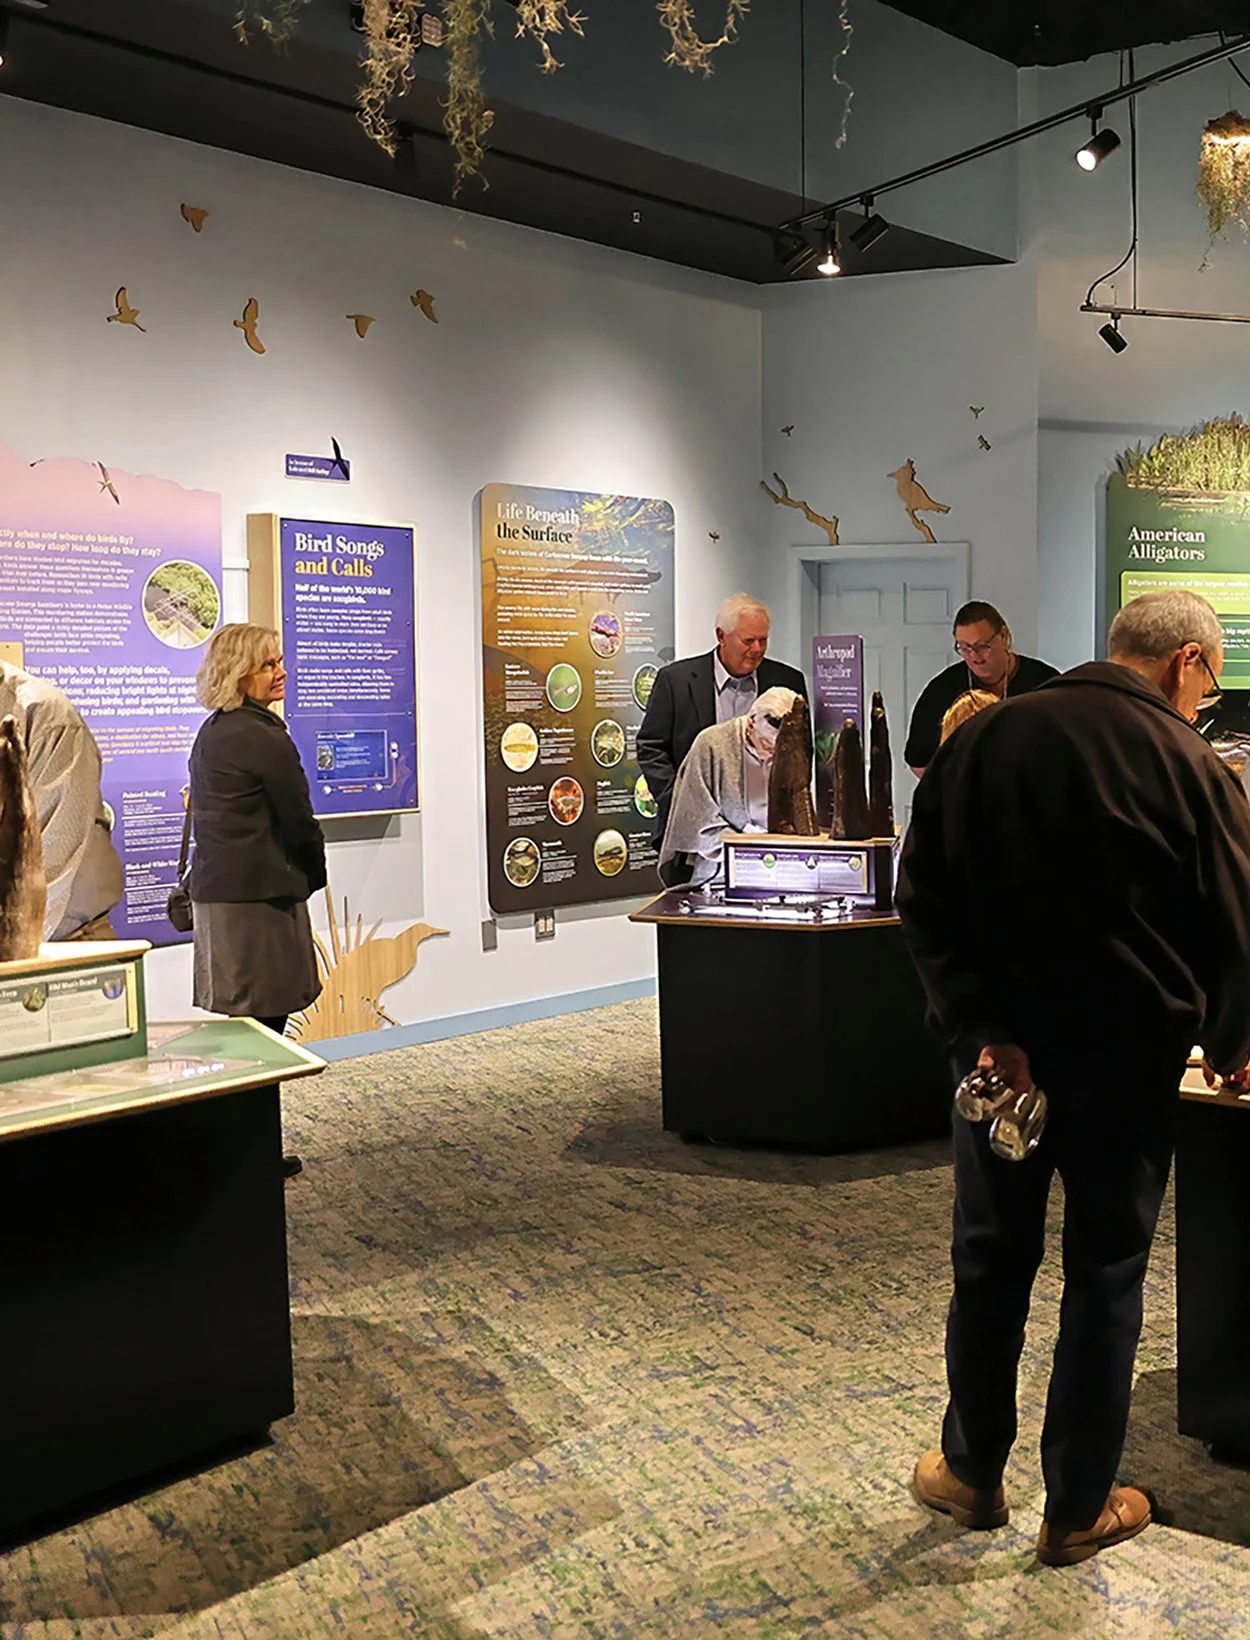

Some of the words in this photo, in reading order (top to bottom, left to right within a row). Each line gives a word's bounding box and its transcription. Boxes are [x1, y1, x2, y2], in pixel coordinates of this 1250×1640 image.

[497, 502, 523, 520] Life
[526, 505, 580, 524] Beneath
[17, 530, 40, 539] when
[41, 531, 57, 540] and
[58, 532, 84, 541] where
[85, 533, 96, 542] do
[99, 534, 118, 543] birds
[497, 522, 519, 539] the
[522, 525, 572, 544] Surface
[1128, 526, 1205, 542] American
[14, 540, 26, 548] do
[27, 541, 46, 551] they
[48, 542, 70, 552] stop?
[71, 544, 89, 552] How
[91, 544, 109, 554] long
[110, 546, 121, 554] do
[122, 547, 139, 556] they
[141, 548, 161, 557] stay?
[295, 532, 333, 552] Bird
[336, 535, 384, 561] Songs
[1128, 545, 1205, 563] Alligators
[295, 556, 328, 575] and
[331, 557, 373, 577] Calls
[310, 584, 318, 592] of
[318, 584, 330, 592] the
[816, 644, 855, 663] Arthropod
[25, 666, 40, 674] You
[59, 665, 78, 676] help,
[80, 666, 96, 676] too,
[98, 665, 107, 676] by
[109, 665, 143, 676] applying
[144, 666, 170, 675] decals,
[70, 676, 92, 685] decor
[106, 677, 124, 686] your
[126, 676, 158, 685] windows
[160, 676, 167, 684] to
[86, 686, 120, 696] reducing
[122, 686, 145, 696] bright
[147, 686, 167, 695] lights
[169, 687, 177, 695] at
[178, 686, 197, 696] night
[125, 697, 138, 705] and
[141, 696, 179, 707] gardening
[180, 696, 196, 704] with
[81, 708, 89, 717] to
[91, 708, 115, 716] create
[117, 707, 154, 718] appealing
[155, 705, 170, 715] bird
